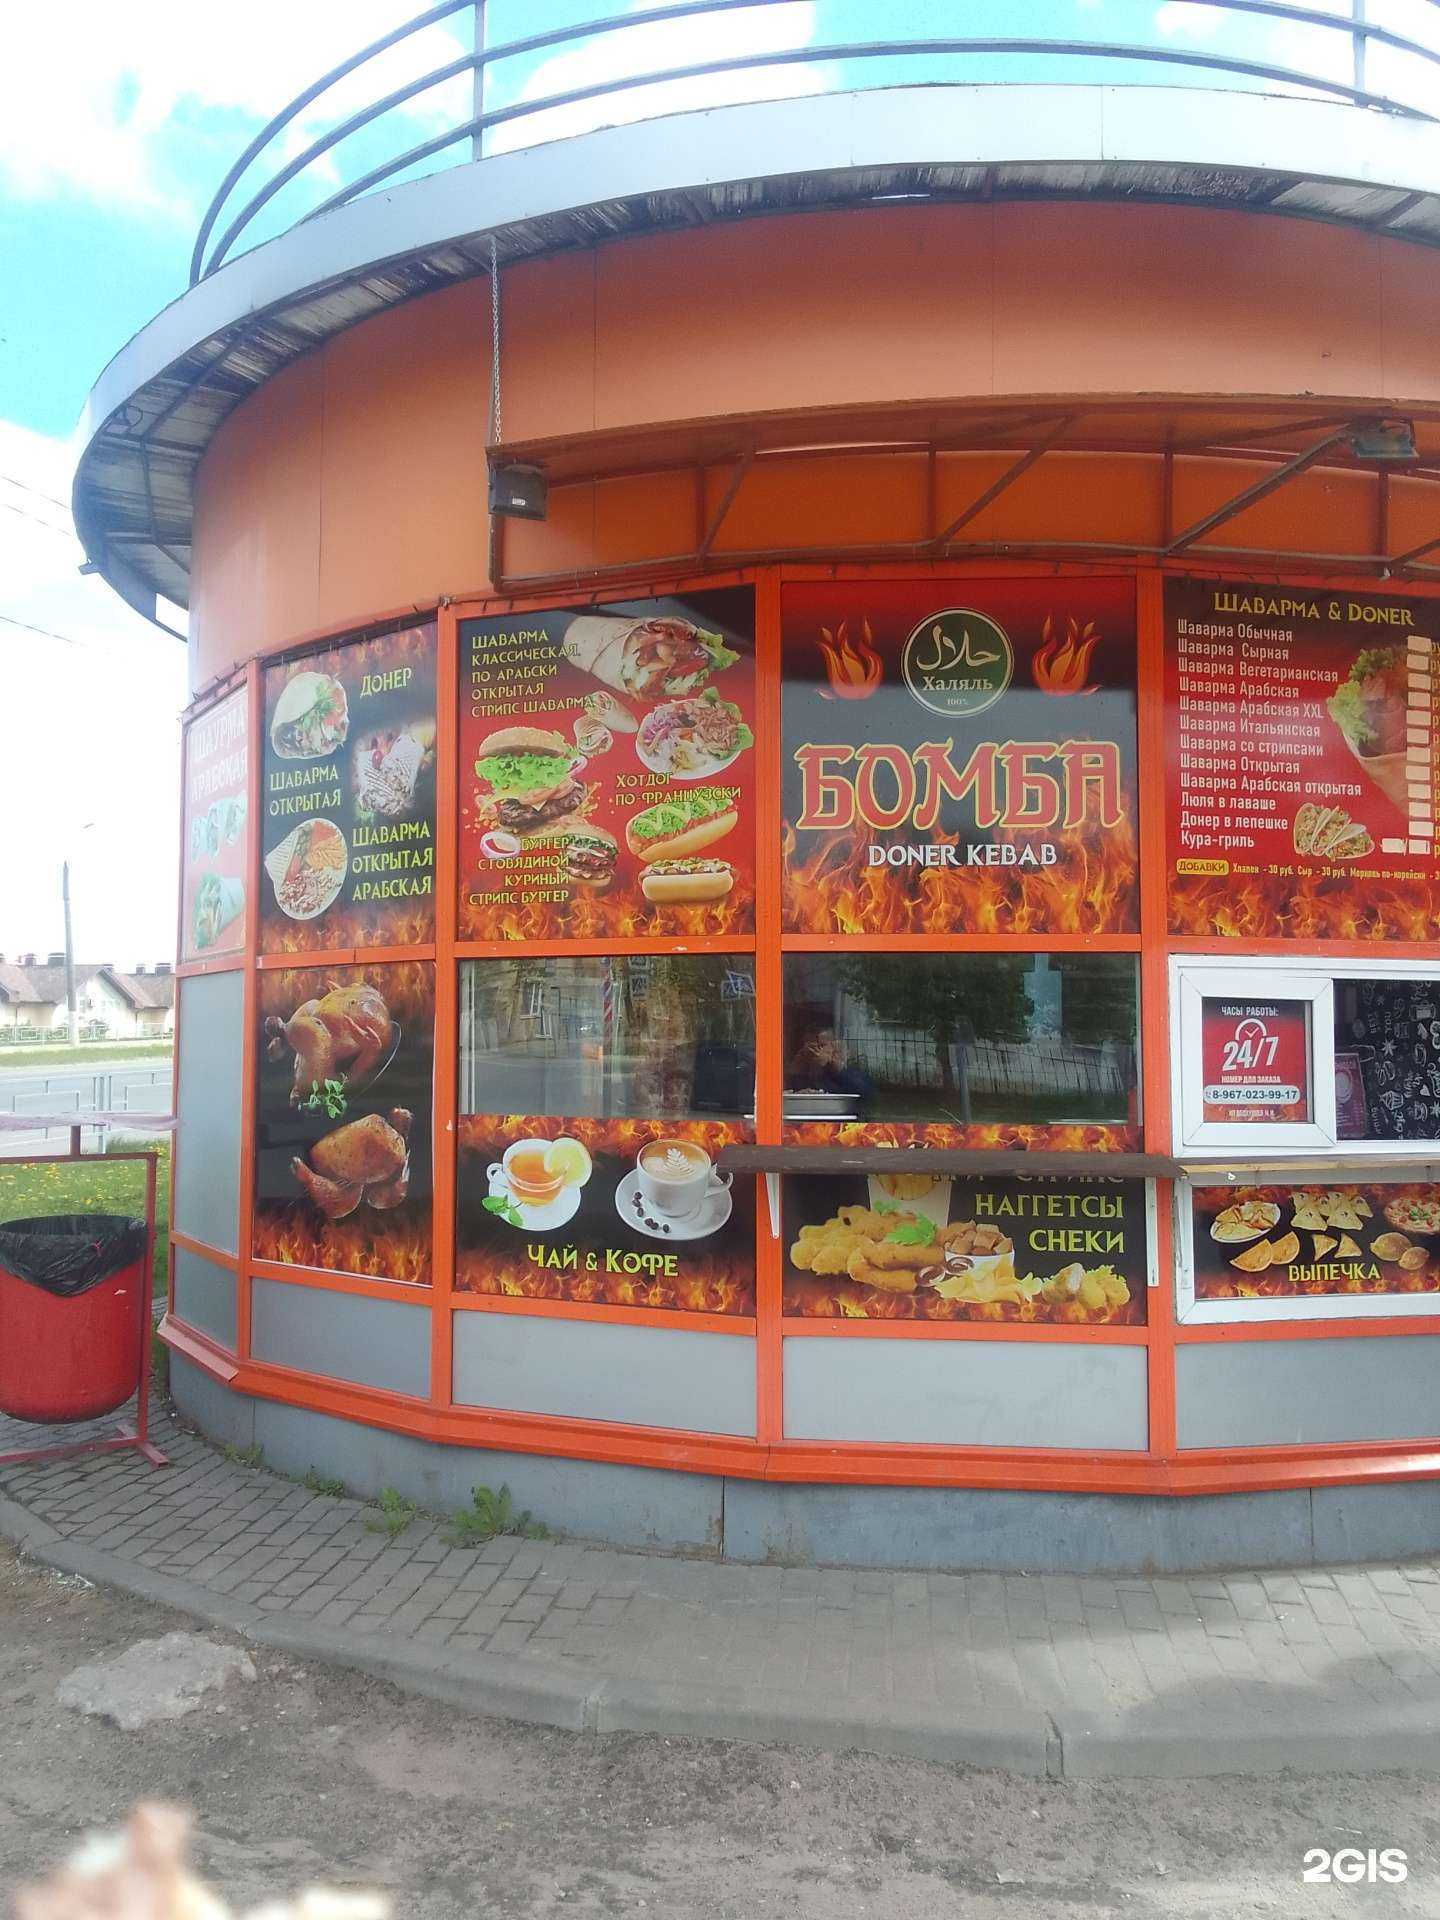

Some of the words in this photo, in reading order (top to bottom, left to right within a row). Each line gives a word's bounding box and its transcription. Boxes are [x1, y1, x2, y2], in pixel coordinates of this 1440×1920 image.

[1328, 603, 1341, 620] &
[472, 629, 549, 649] ШАВАРМА
[1178, 619, 1234, 639] Шаварма
[1238, 624, 1292, 642] Обычная
[916, 625, 1000, 672] حلال
[1178, 638, 1234, 658] Шаварма
[1242, 642, 1289, 661] Сырная
[472, 671, 491, 684] ПО
[497, 664, 557, 682] АРАБСКИ
[1178, 657, 1234, 677] Шаварма
[1240, 662, 1338, 682] Вегетарианская
[360, 667, 413, 698] ДОНЕР
[471, 682, 545, 701] ОТКРЫТАЯ
[922, 676, 993, 690] Халяль
[1180, 676, 1235, 696] Шаварма
[1240, 682, 1299, 699] Арабская
[471, 702, 521, 718] СТРИПС
[523, 697, 594, 714] ШАВАРМА
[1180, 696, 1236, 715] Шаварма
[1240, 700, 1299, 718] Арабская
[1303, 704, 1324, 718] XXL
[1180, 715, 1236, 734] Шаварма
[1240, 719, 1320, 738] Итальянская
[1180, 734, 1236, 753] Шаварма
[1240, 741, 1254, 752] со
[1259, 742, 1324, 757] стрипсами
[1180, 754, 1236, 772] Шаварма
[1241, 757, 1300, 775] Открытая
[270, 764, 339, 792] ШАВАРМА
[616, 771, 673, 788] ХОТДОГ
[794, 737, 1125, 830] БОМБА
[1180, 773, 1236, 791] Шаварма
[1241, 776, 1300, 794] Арабская
[1306, 781, 1362, 797] открытая
[269, 788, 342, 817] ОТКРЫТАЯ
[1181, 792, 1214, 808] Люля
[1219, 797, 1224, 808] в
[1230, 798, 1276, 810] лаваше
[1181, 811, 1220, 829] Донер
[1224, 817, 1231, 828] в
[1236, 816, 1288, 831] лепешке
[352, 820, 431, 848] ШАВАРМА
[521, 837, 570, 851] БУРГЕР
[1181, 830, 1254, 848] Кура-гриль
[351, 847, 433, 874] ОТКРЫТАЯ
[478, 859, 487, 870] С
[490, 852, 569, 870] ГОВЯДИНОЙ
[868, 845, 960, 868] DONER
[967, 844, 1058, 867] KEBAB
[505, 869, 569, 886] КУРИНЫЙ
[1178, 861, 1227, 874] ДОБАВКИ
[1268, 865, 1278, 874] 30
[1297, 865, 1313, 877] Сыр
[1321, 866, 1331, 876] 30
[351, 875, 432, 901] АРАБСКАЯ
[469, 892, 519, 905] СТРИПС
[521, 890, 569, 904] БУРГЕР
[1221, 1007, 1243, 1016] ЧАСЫ
[1246, 1007, 1279, 1016] РАБОТЫ:
[1222, 1036, 1279, 1071] 24/7
[1212, 1090, 1298, 1099] 8-967-023-99-17
[975, 1193, 1124, 1219] НАГГЕТСЫ
[1028, 1229, 1125, 1254] СНЕКИ
[528, 1243, 578, 1271] ЧАЙ
[585, 1252, 598, 1272] &
[606, 1248, 680, 1277] КОФЕ
[1288, 1263, 1382, 1282] ВЫПЕЧКА
